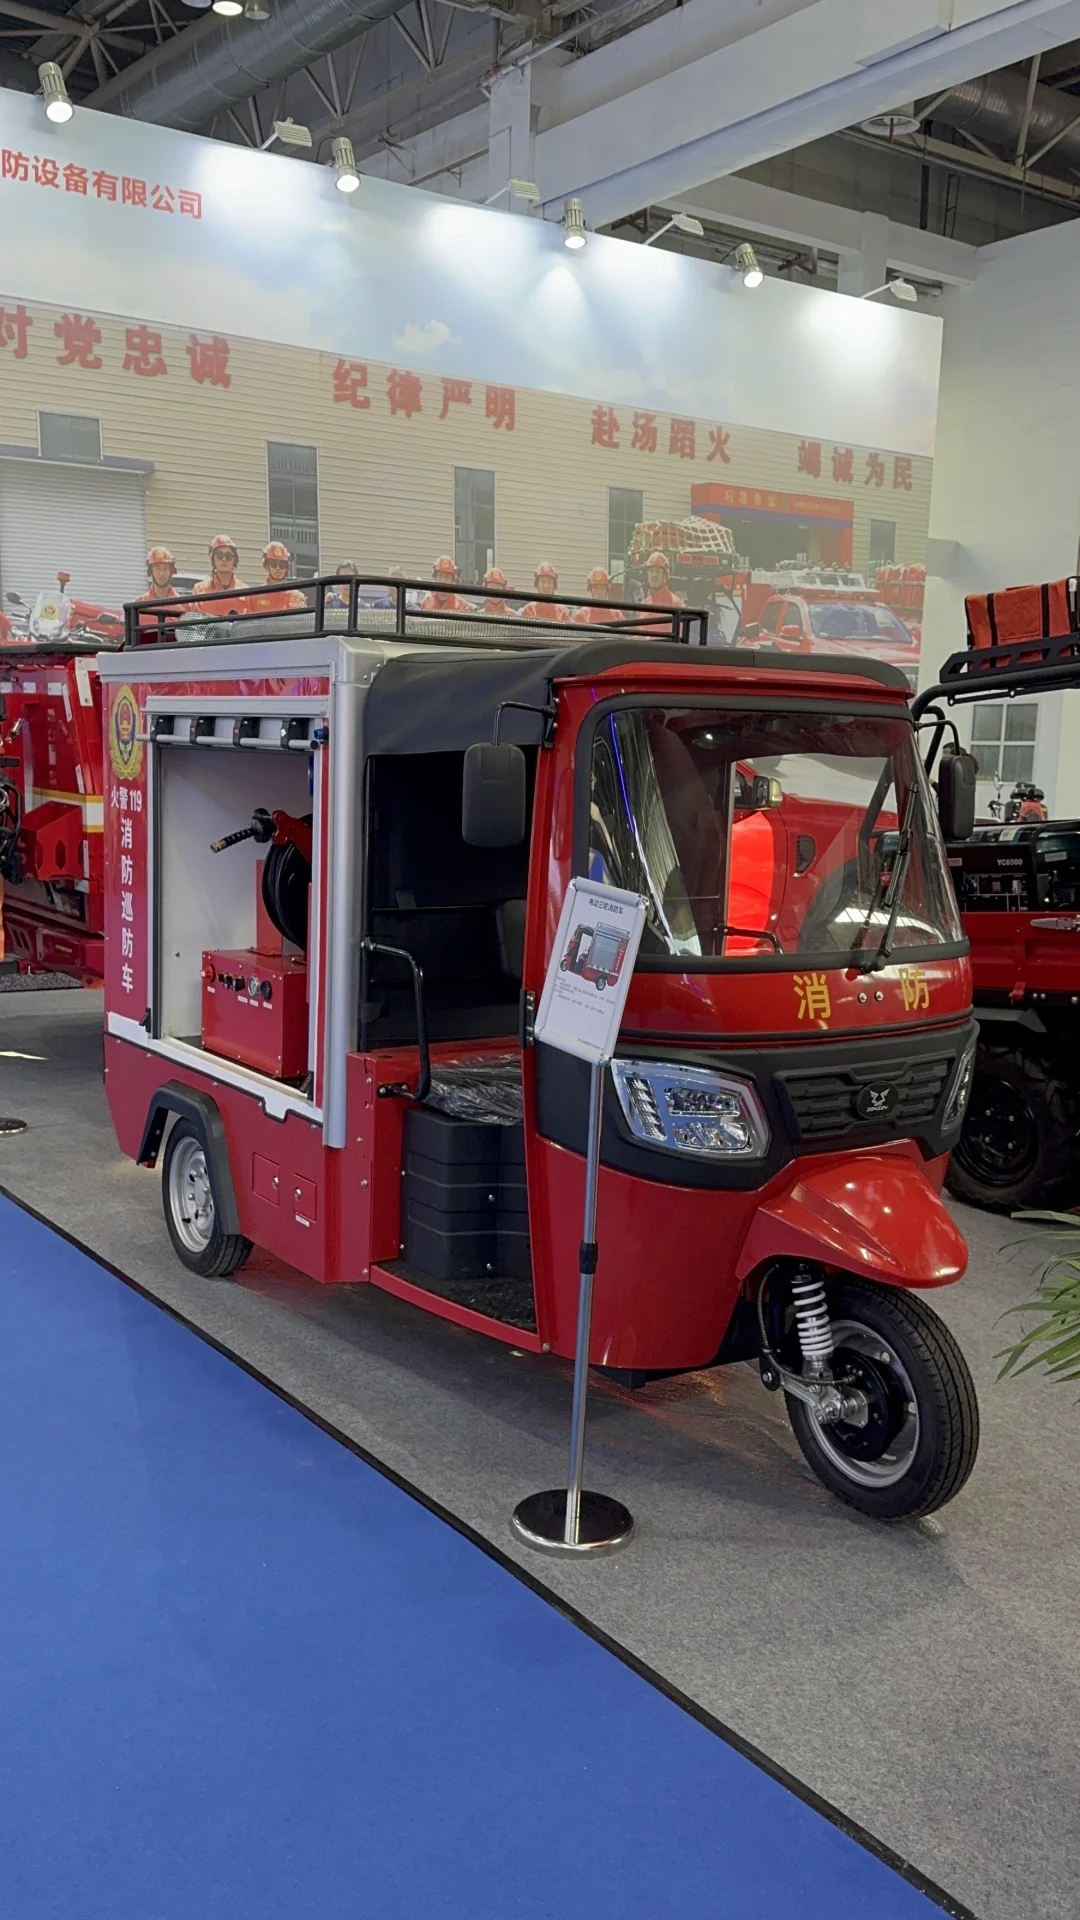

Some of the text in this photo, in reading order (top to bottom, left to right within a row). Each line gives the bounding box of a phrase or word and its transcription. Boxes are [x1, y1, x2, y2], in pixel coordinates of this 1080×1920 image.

[1, 148, 203, 220] 防设备有限公司
[333, 357, 515, 431] 纪律严明
[591, 405, 732, 465] 赴汤蹈火
[121, 818, 134, 994] 消防巡防车
[793, 968, 930, 1019] 消防
